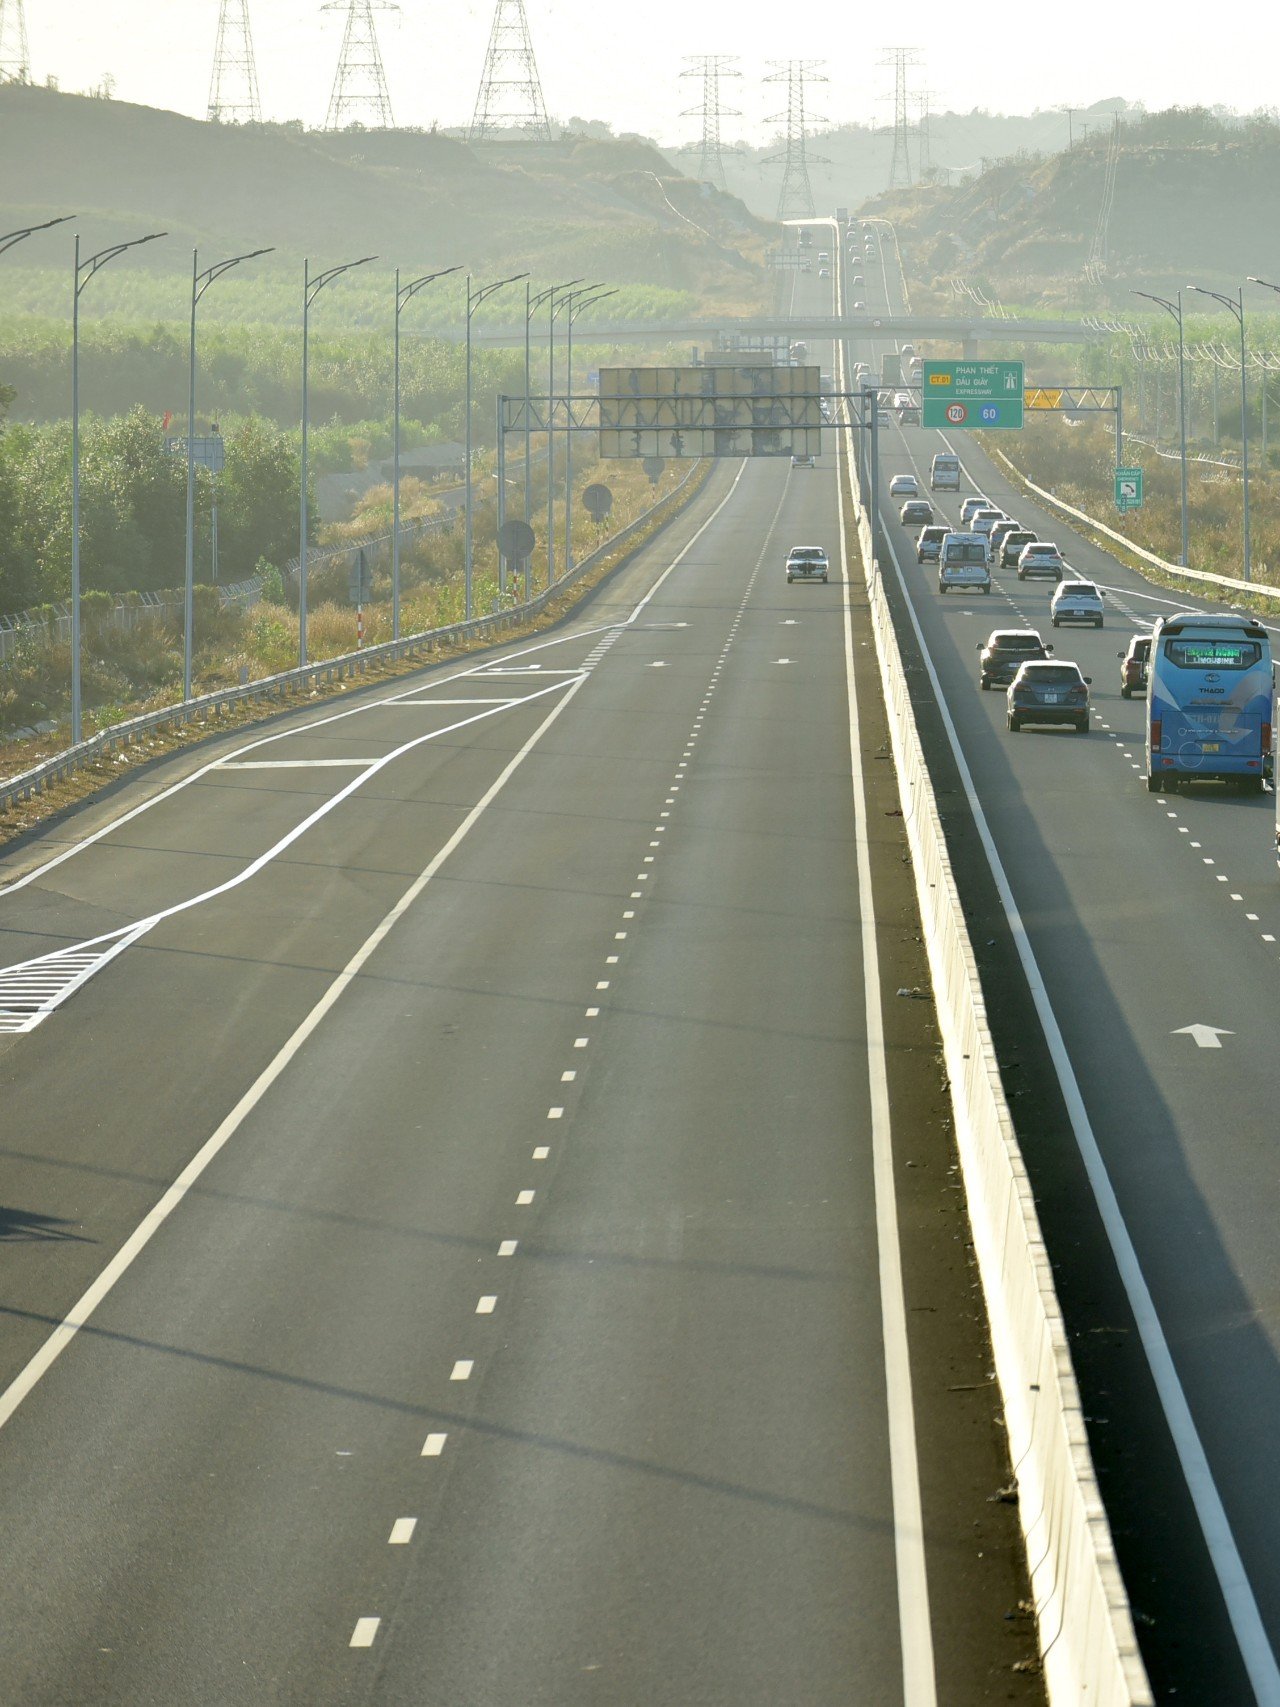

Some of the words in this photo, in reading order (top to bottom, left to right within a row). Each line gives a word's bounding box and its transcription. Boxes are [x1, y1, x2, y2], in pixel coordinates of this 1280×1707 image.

[950, 408, 963, 419] 120
[982, 408, 996, 419] 60
[1193, 657, 1235, 665] LIMOUSINE
